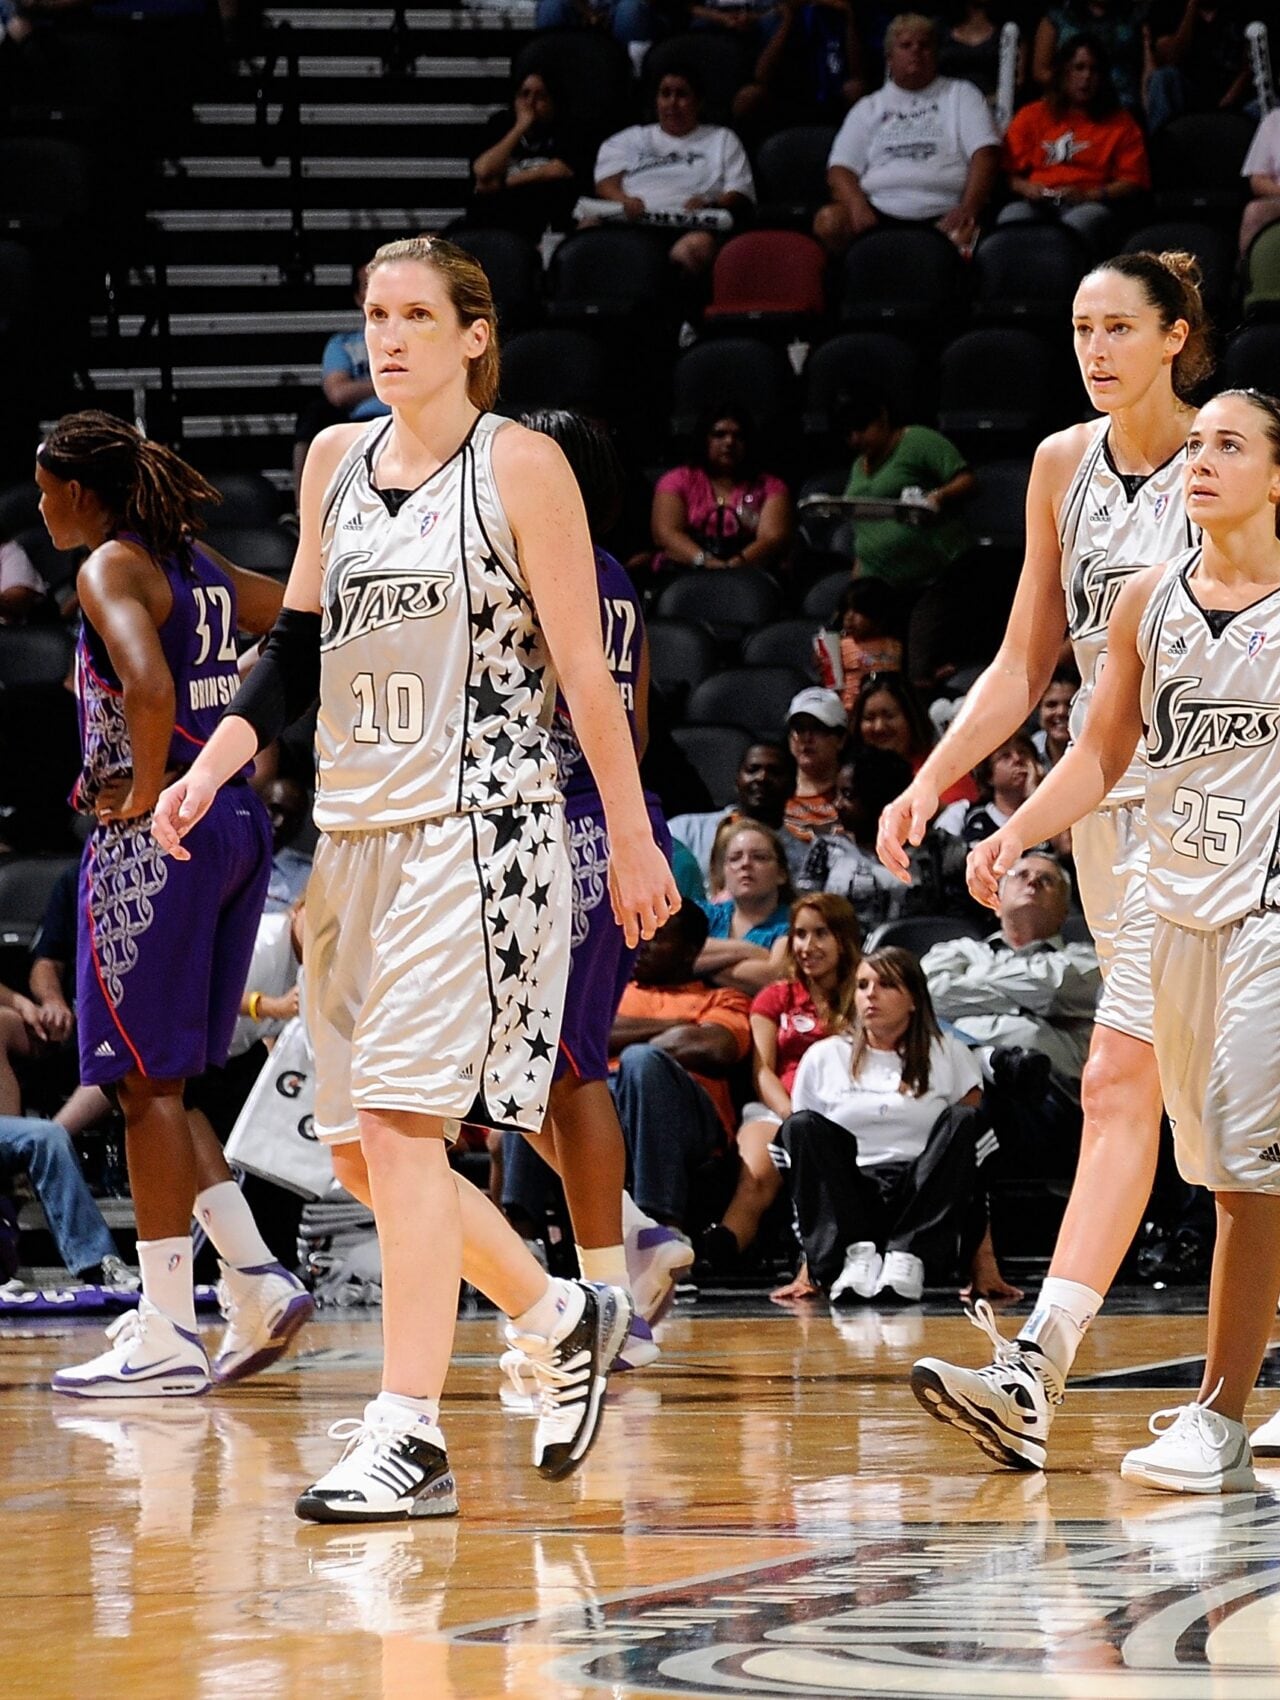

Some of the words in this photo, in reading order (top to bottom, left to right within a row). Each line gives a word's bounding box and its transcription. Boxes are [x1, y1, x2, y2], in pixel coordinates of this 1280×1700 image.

[192, 585, 237, 665] 32
[321, 551, 455, 653] STARS
[351, 671, 424, 744] 10
[1171, 787, 1246, 866] 25
[276, 1070, 307, 1098] G
